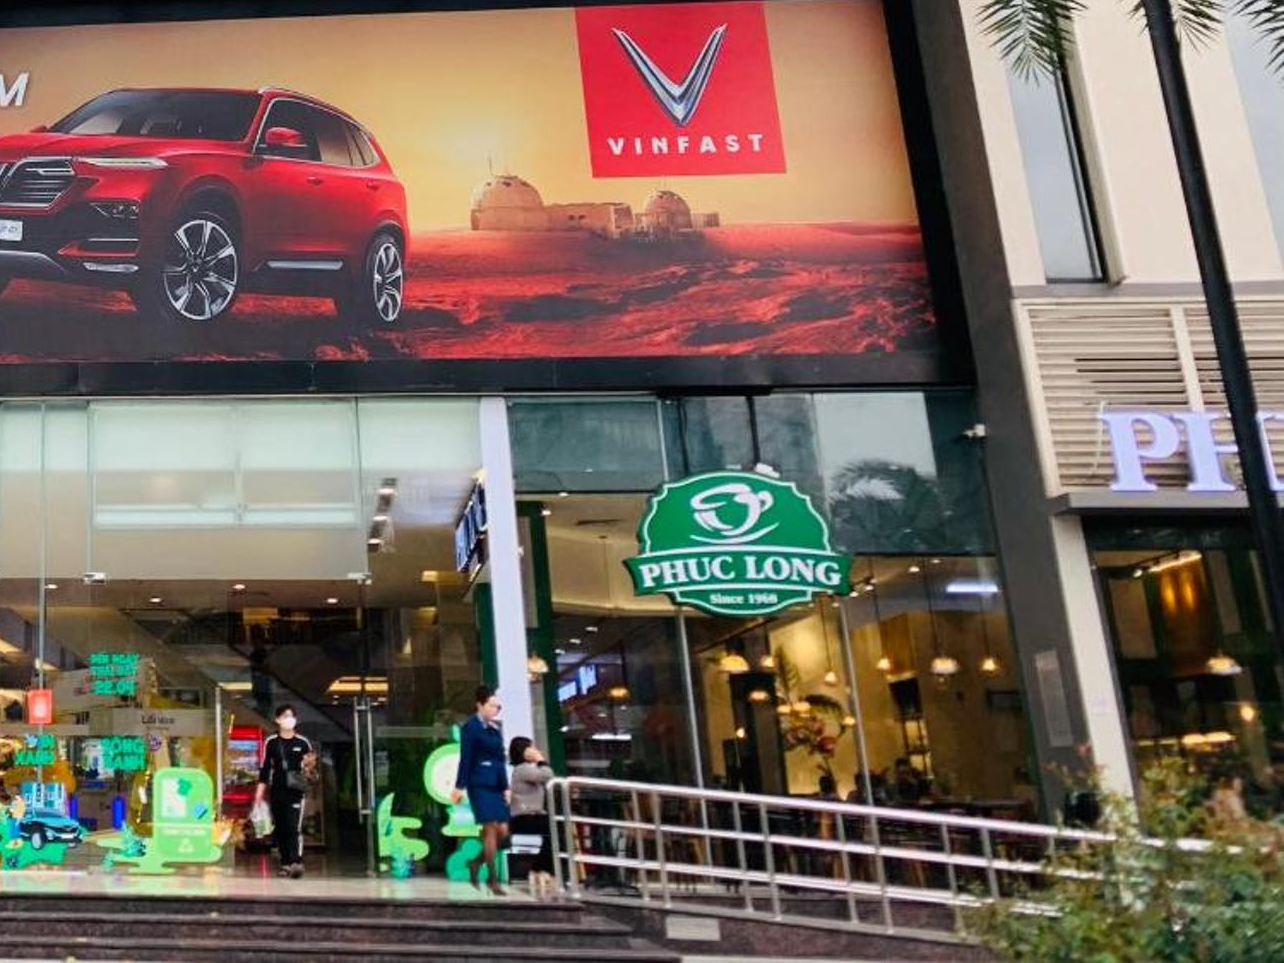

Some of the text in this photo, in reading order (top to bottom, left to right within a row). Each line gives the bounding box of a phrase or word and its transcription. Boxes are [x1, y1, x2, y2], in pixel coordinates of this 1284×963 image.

[607, 134, 763, 156] VINFAST
[639, 555, 842, 588] PHUC LONG
[710, 593, 745, 605] Since
